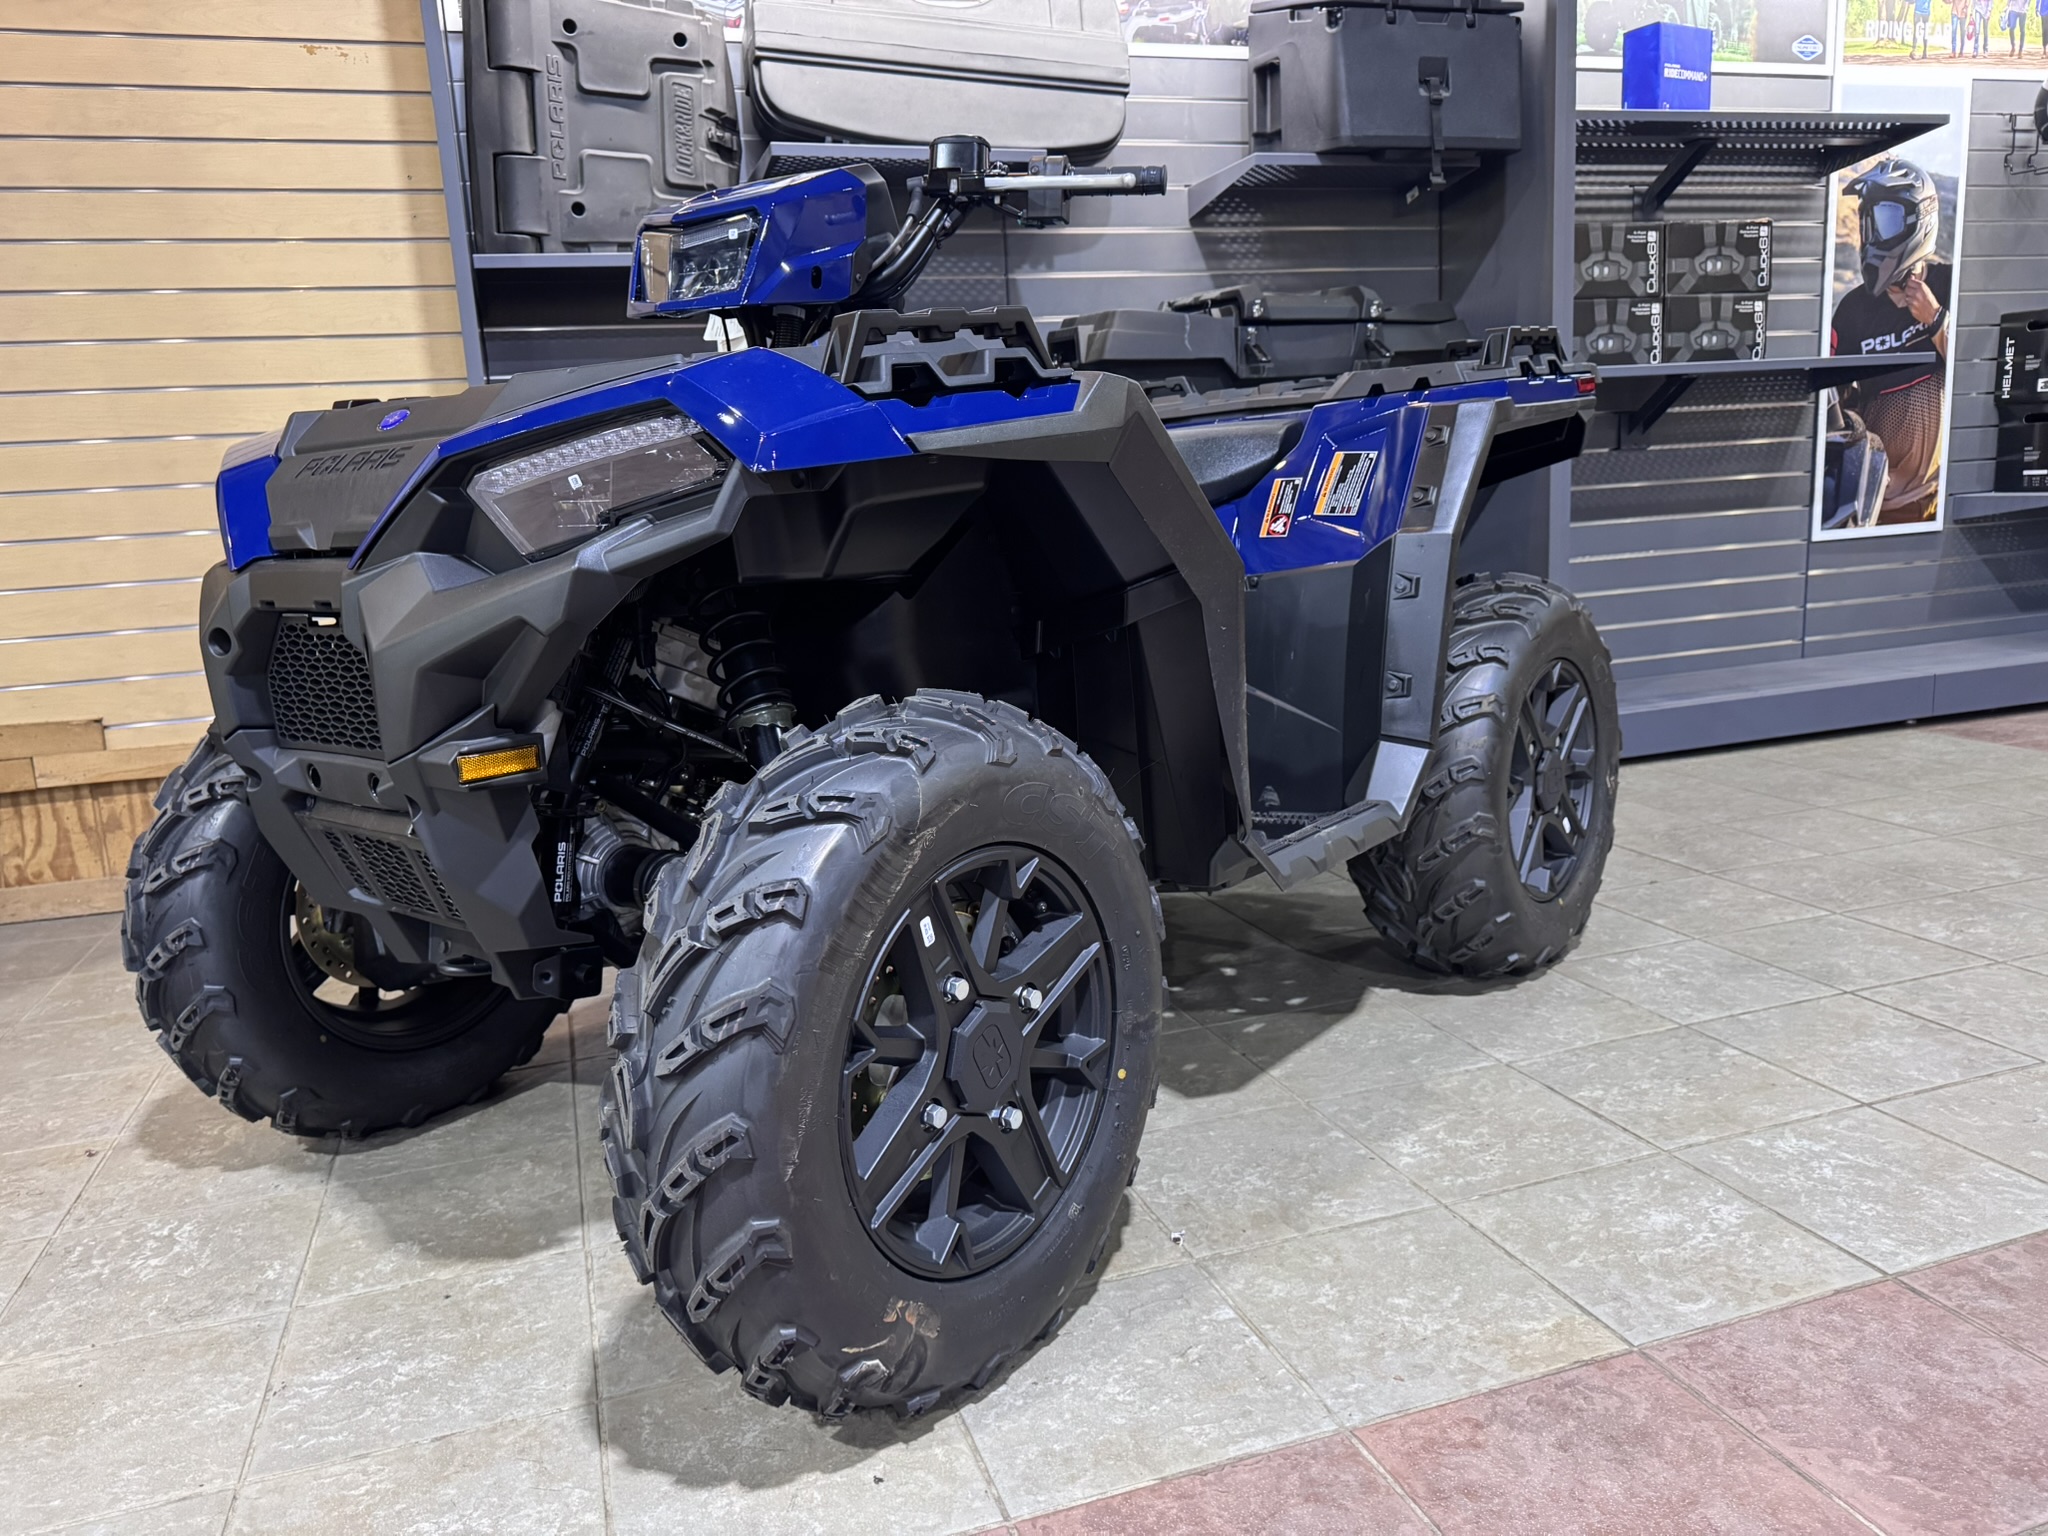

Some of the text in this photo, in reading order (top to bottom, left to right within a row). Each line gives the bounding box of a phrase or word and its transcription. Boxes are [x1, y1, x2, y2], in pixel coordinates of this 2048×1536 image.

[1866, 20, 1913, 39] RIDING
[546, 54, 567, 181] POLARIS
[671, 81, 695, 178] LOCK&RIDE
[2001, 336, 2015, 399] HELMET
[295, 445, 413, 478] POLARIS
[1002, 781, 1120, 861] CST
[553, 841, 567, 903] POLARIS
